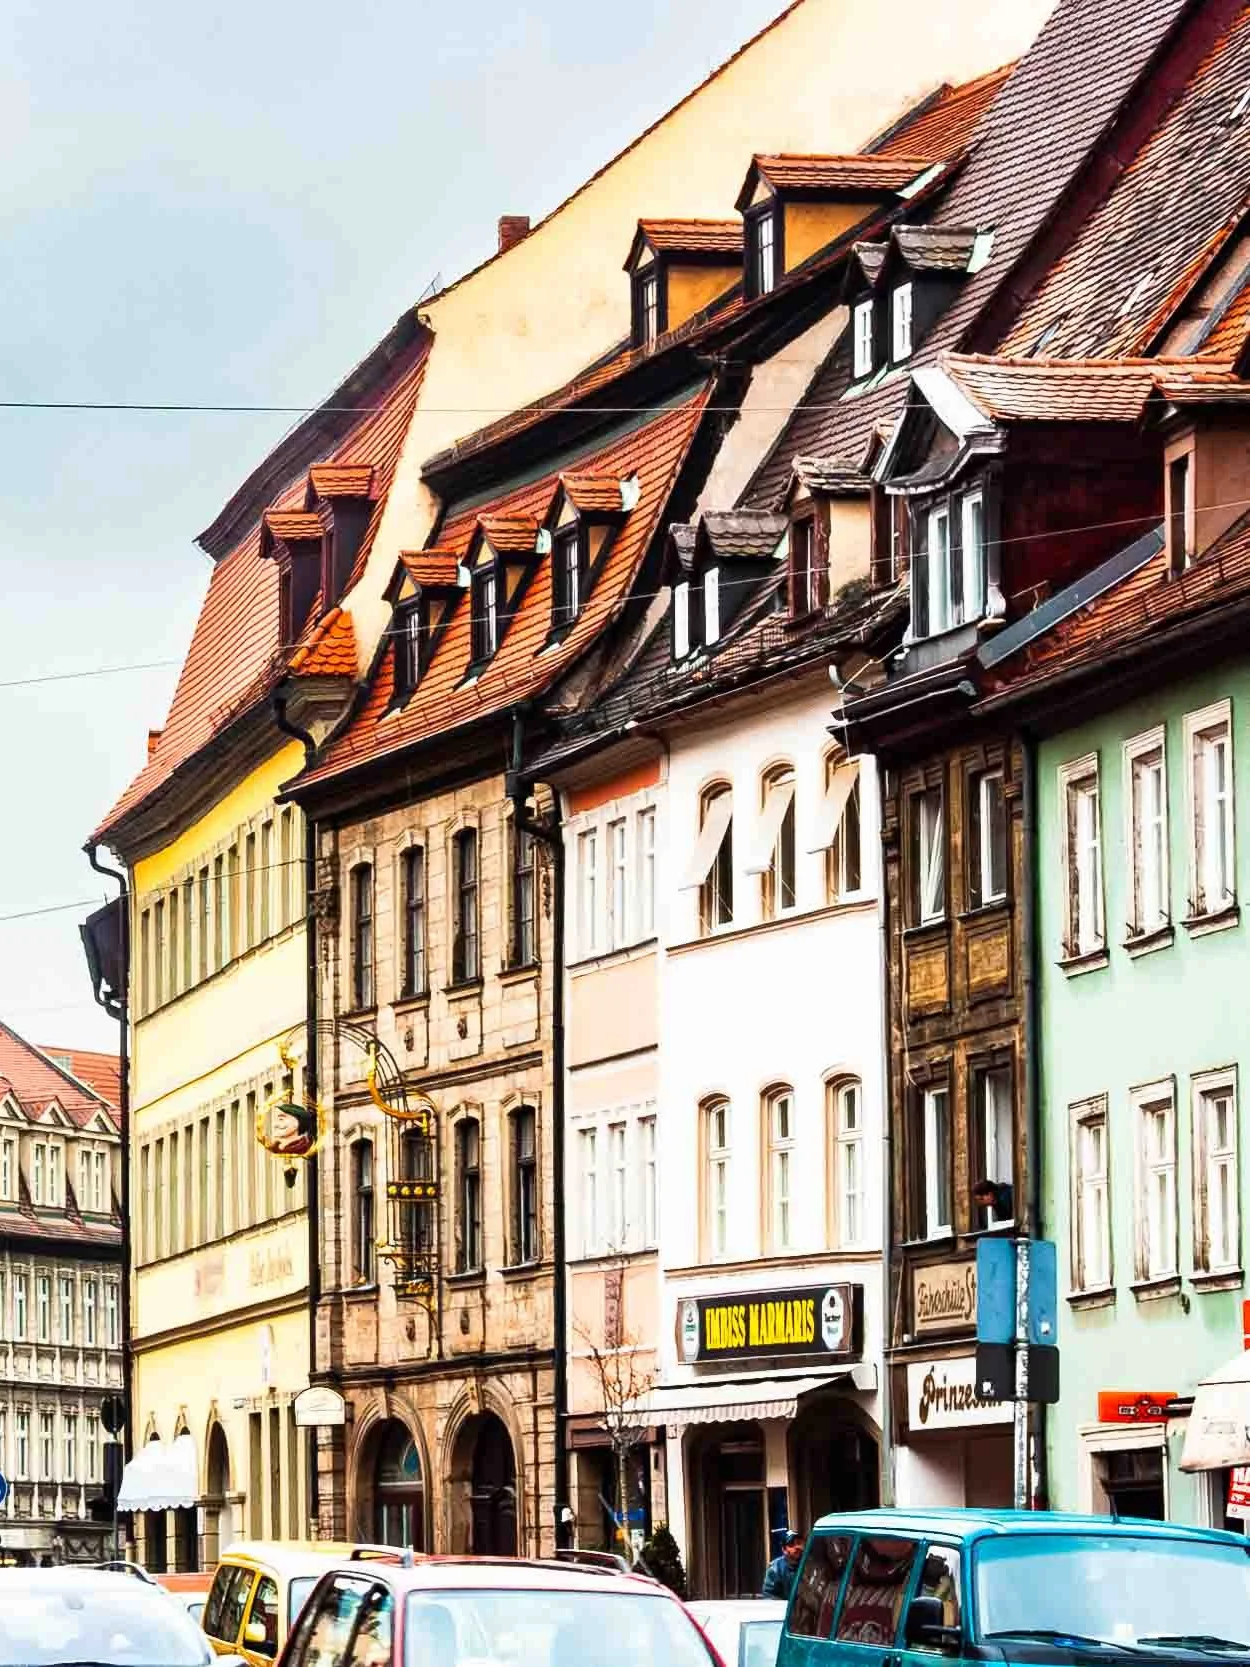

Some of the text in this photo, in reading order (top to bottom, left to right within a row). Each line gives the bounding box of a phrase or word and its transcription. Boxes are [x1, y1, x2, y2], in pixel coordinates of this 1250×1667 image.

[705, 1298, 815, 1350] IMBISS MARMARIS
[919, 1365, 1002, 1424] Prinze
